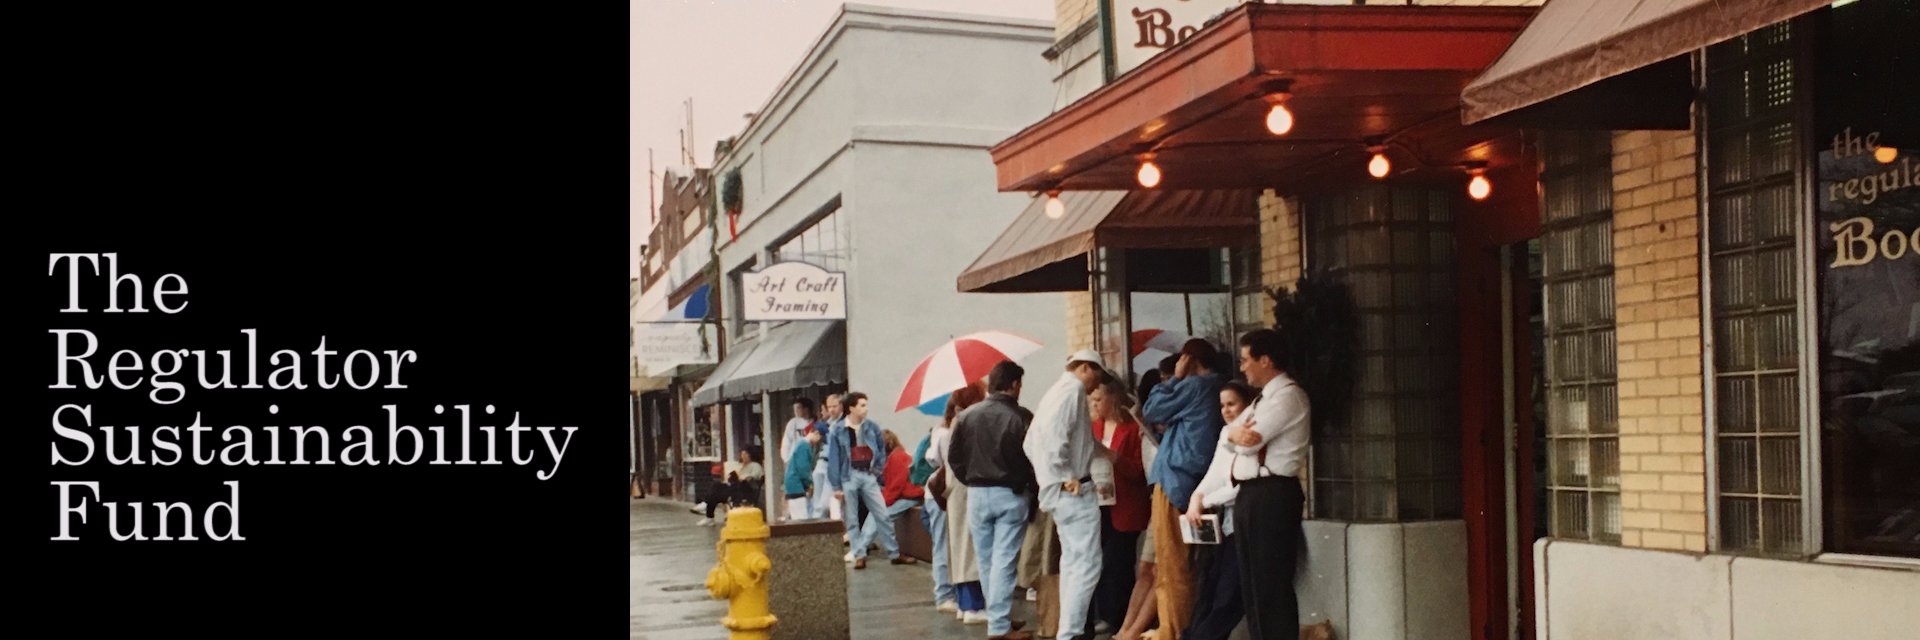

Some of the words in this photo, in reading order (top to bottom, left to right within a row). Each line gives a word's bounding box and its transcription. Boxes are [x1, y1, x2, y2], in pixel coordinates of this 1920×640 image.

[1831, 126, 1880, 160] the
[750, 275, 787, 293] Art
[796, 276, 838, 293] Craft
[761, 296, 829, 315] Framing
